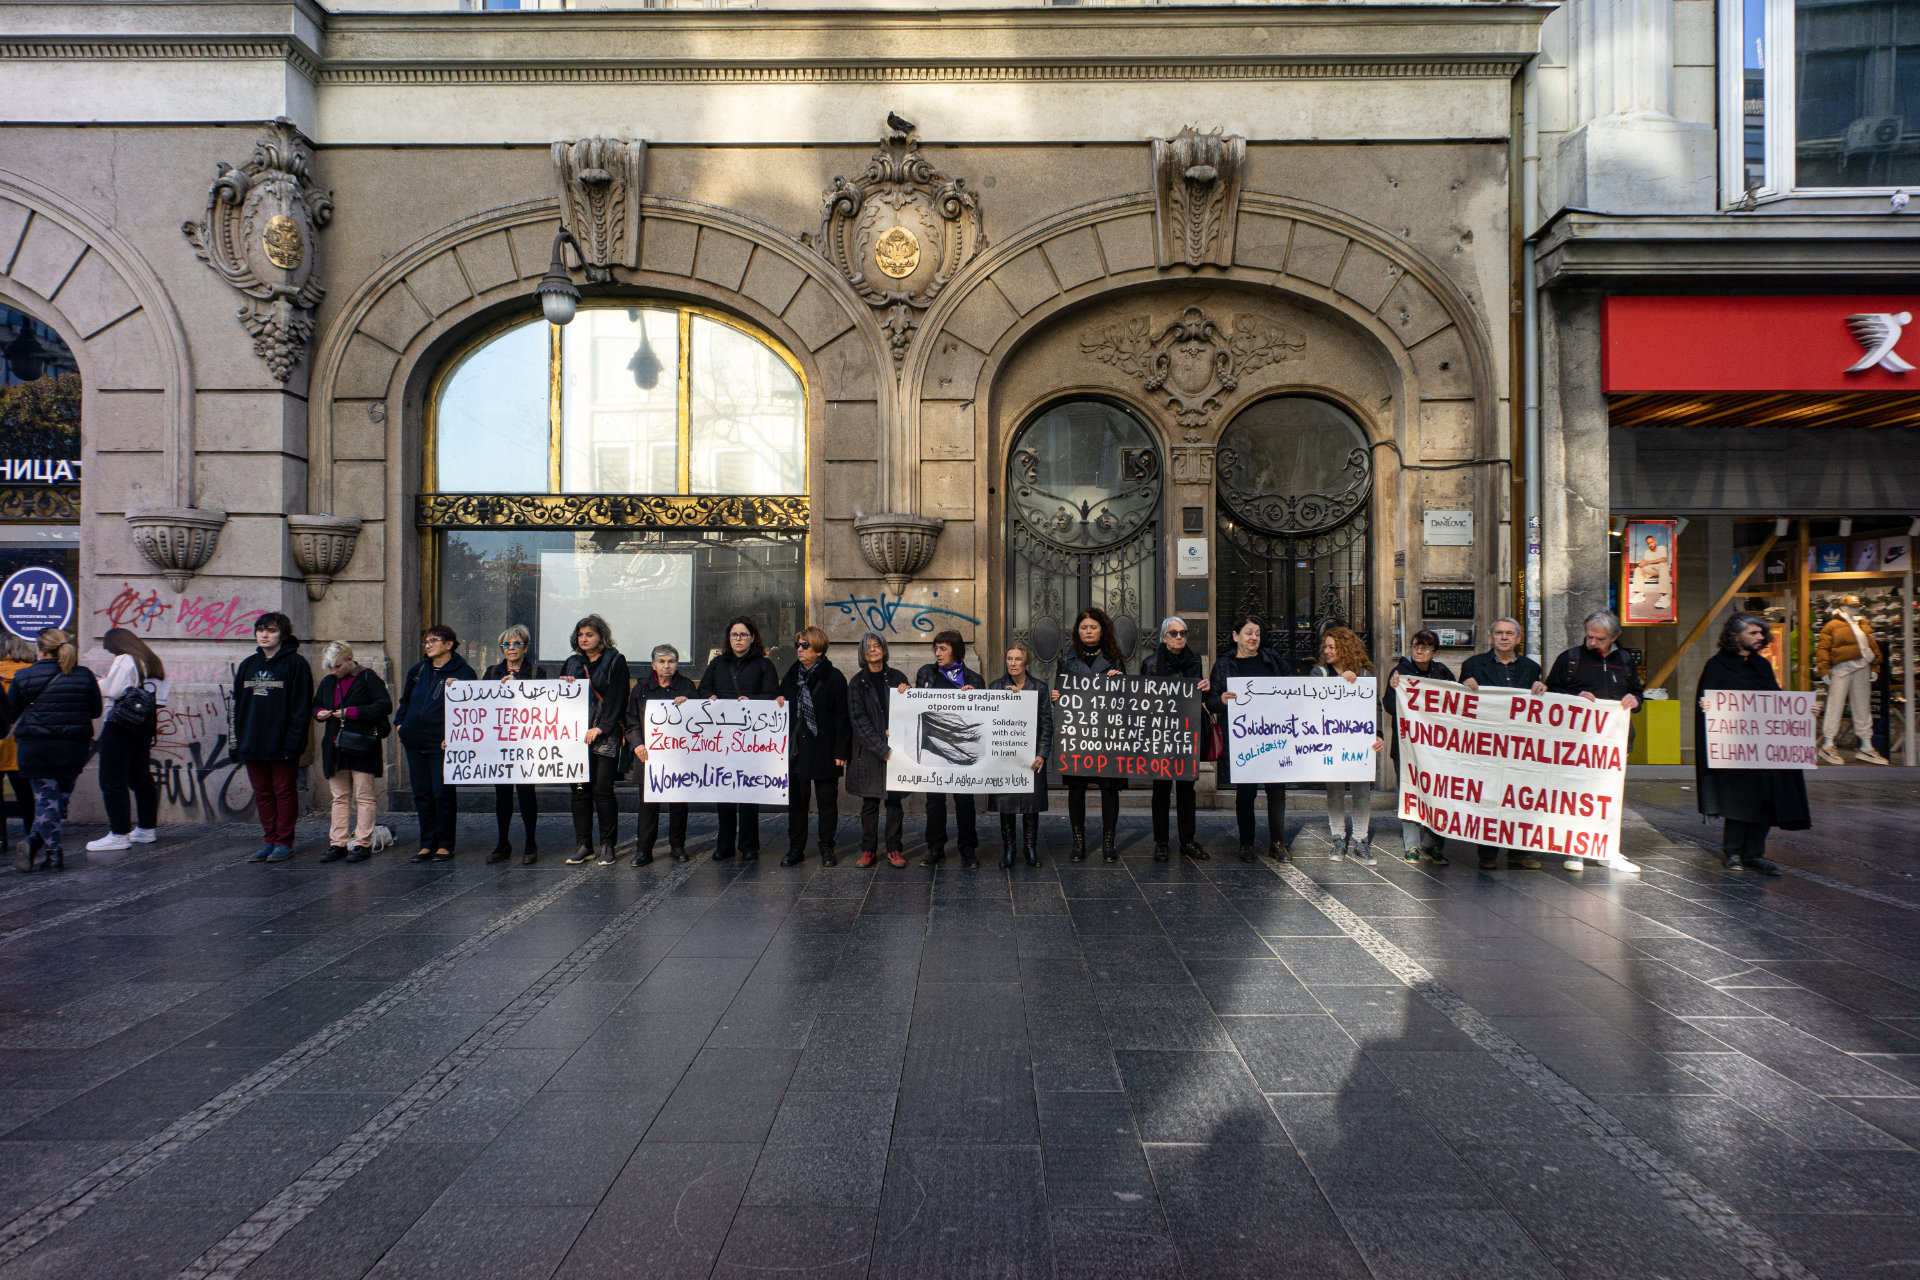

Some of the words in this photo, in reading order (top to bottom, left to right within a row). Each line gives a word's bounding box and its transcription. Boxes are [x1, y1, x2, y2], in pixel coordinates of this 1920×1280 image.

[12, 583, 59, 611] 24/7
[1131, 680, 1139, 693] U
[906, 691, 955, 700] Solidarnost
[968, 692, 1022, 702] gradjanskim
[1059, 694, 1083, 709] OD
[1716, 692, 1807, 715] PAMTIMO
[928, 704, 965, 712] otporom
[974, 704, 999, 712] Iranu!
[1406, 678, 1479, 719] ŽENE
[1510, 697, 1609, 734] PROTIV
[453, 708, 487, 727] STOP
[495, 707, 559, 725] TERORU
[992, 719, 1028, 728] Solidarity
[1064, 710, 1099, 725] 328
[450, 727, 484, 743] NAD
[493, 721, 578, 742] ŽENAMA!
[1010, 729, 1026, 737] civic
[1060, 725, 1077, 735] 50
[1233, 714, 1299, 738] Solidarnost
[1707, 719, 1760, 735] ZAHRA
[992, 739, 1028, 747] resistance
[1060, 738, 1077, 751] 15
[1080, 740, 1102, 750] 000
[446, 750, 476, 764] STOP
[500, 746, 563, 761] TERROR
[992, 749, 999, 757] in
[1000, 749, 1017, 757] Iran!
[1710, 743, 1759, 761] ELHAM
[520, 762, 584, 779] WOMEN!
[1059, 754, 1108, 773] STOP
[1501, 784, 1612, 820] AGAINST
[1404, 792, 1608, 858] FUNDAMENTALISM
